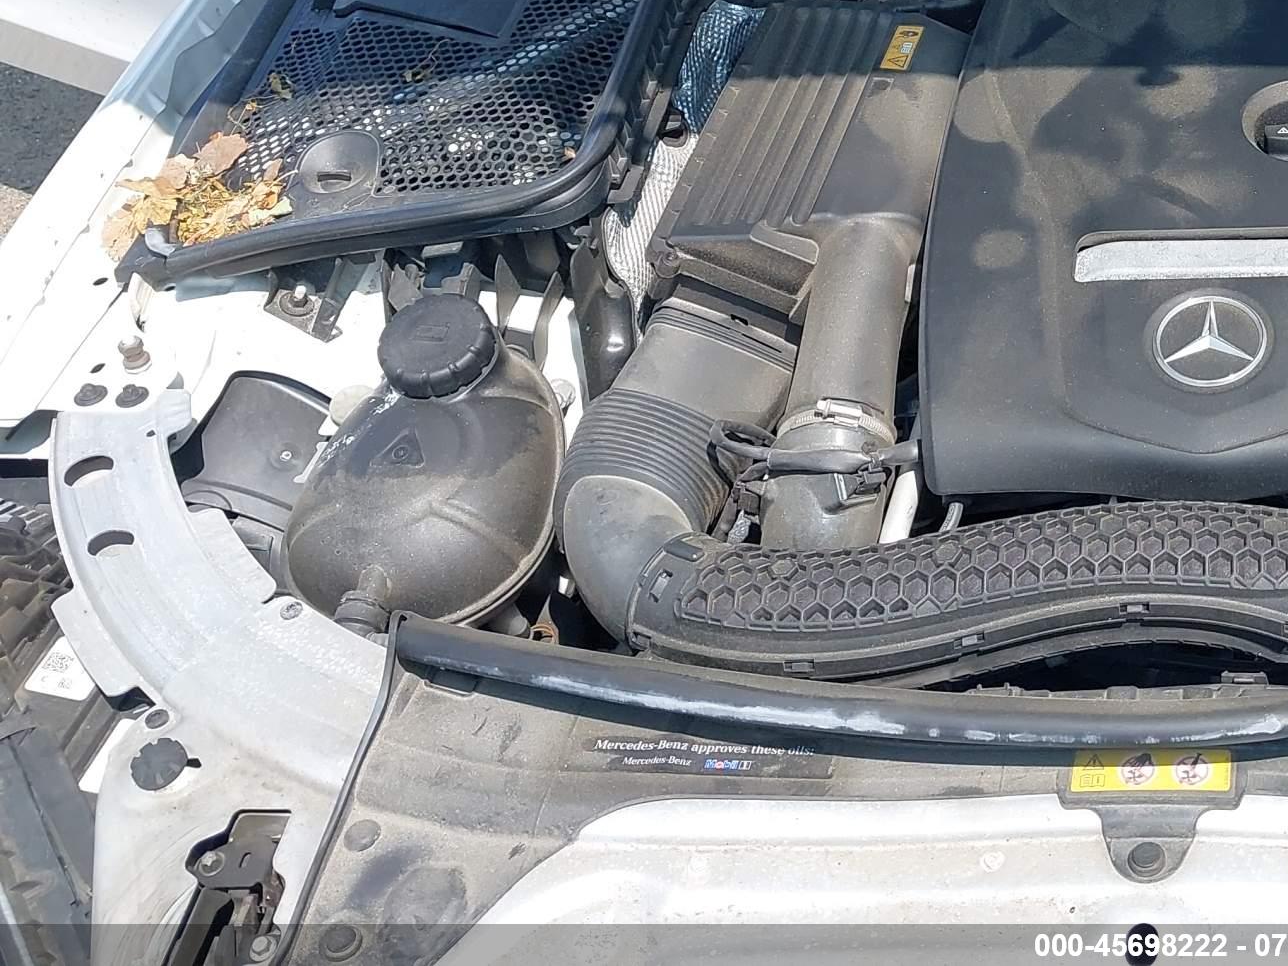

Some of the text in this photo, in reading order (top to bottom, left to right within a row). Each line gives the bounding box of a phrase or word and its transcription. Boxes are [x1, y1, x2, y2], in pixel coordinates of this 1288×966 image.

[594, 739, 815, 755] Mercedes-Benz approves these oils:
[622, 755, 692, 766] Mercedes-Benz
[704, 759, 738, 770] Mobil
